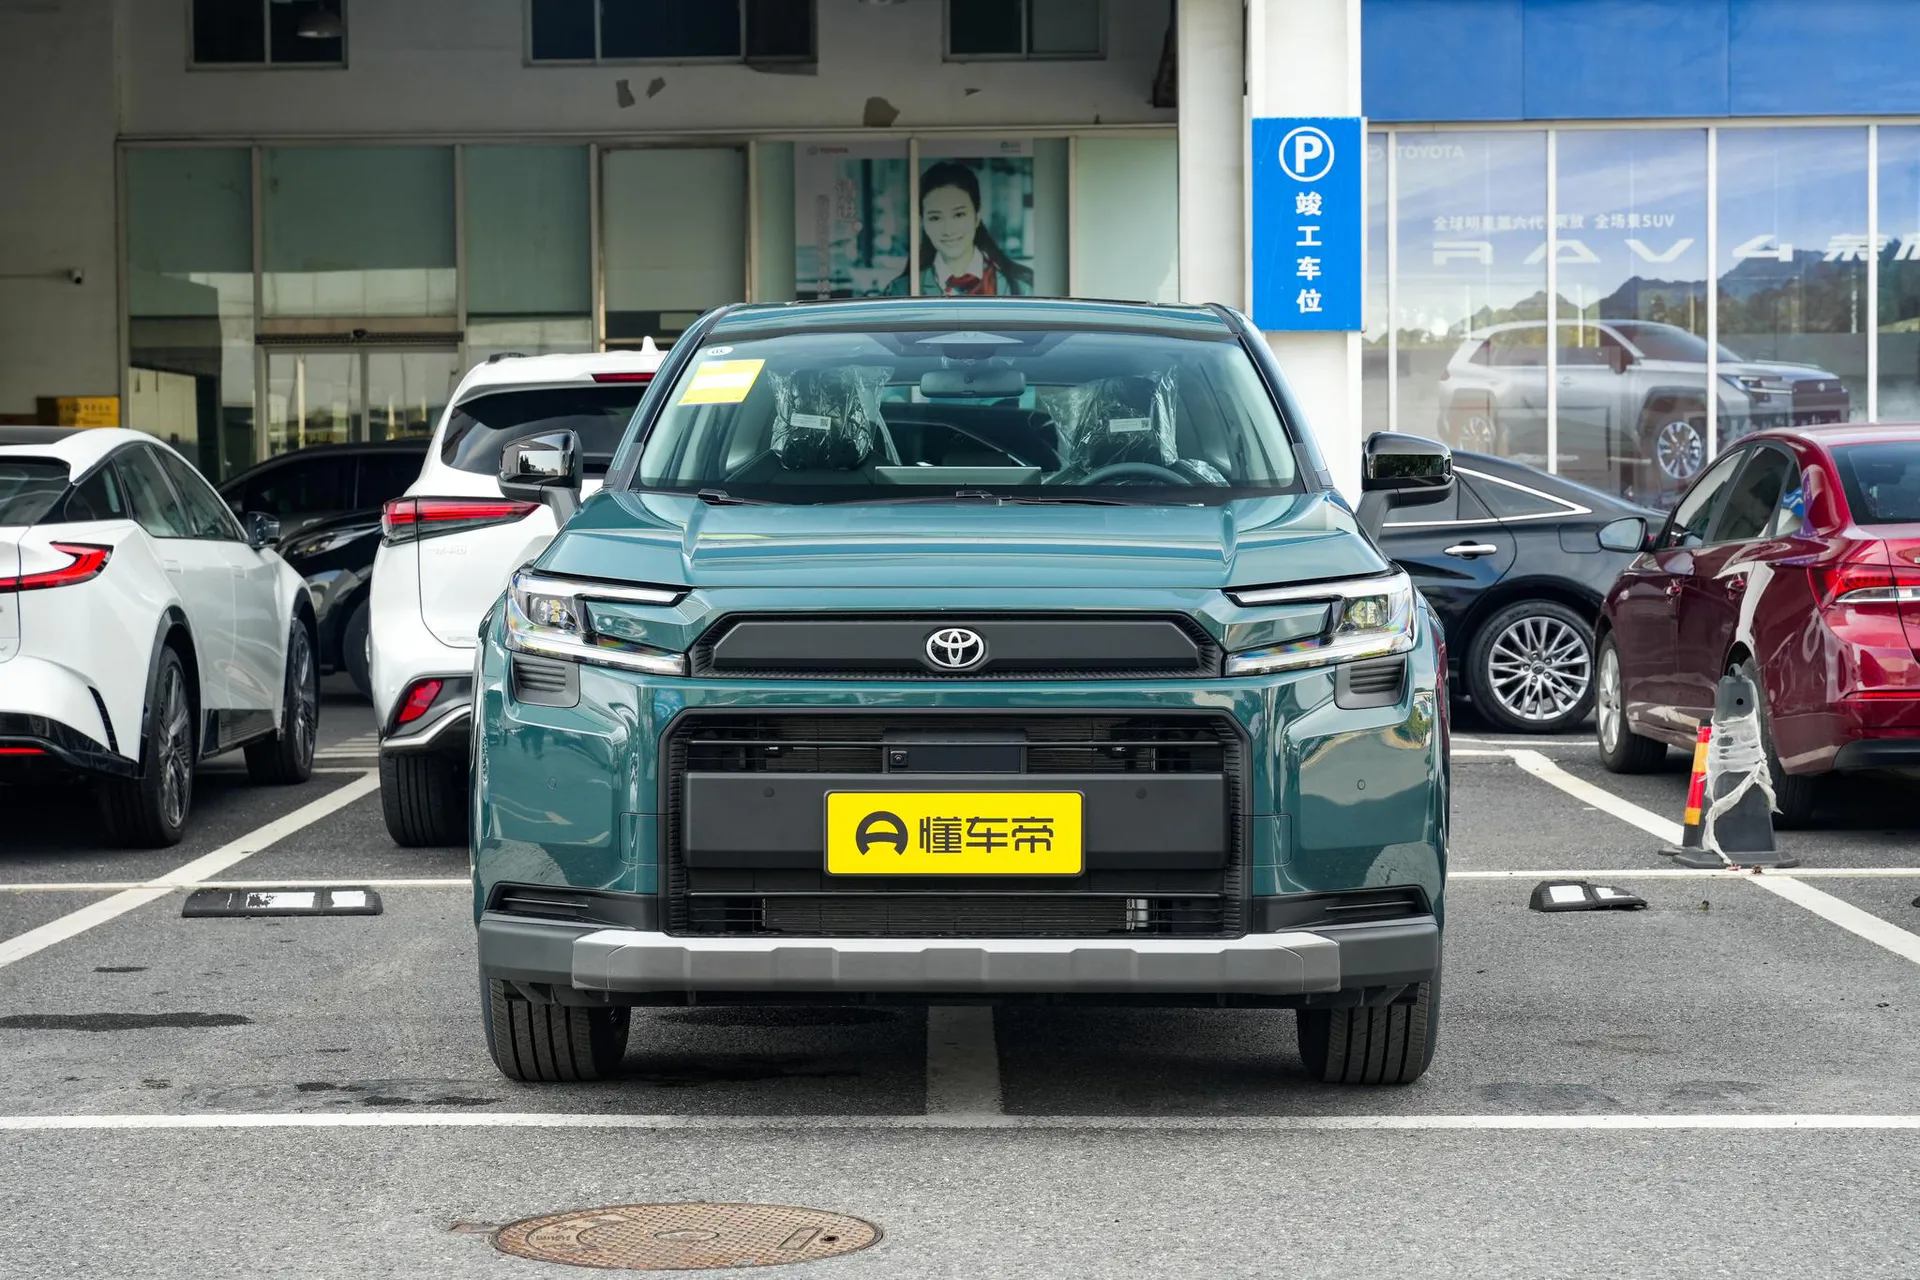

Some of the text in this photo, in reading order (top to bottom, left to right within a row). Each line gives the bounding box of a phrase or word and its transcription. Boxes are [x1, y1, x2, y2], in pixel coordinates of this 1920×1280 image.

[1396, 144, 1465, 160] TOYOTA
[1295, 191, 1323, 314] 竣工车位
[919, 816, 1054, 854] 懂车帝
